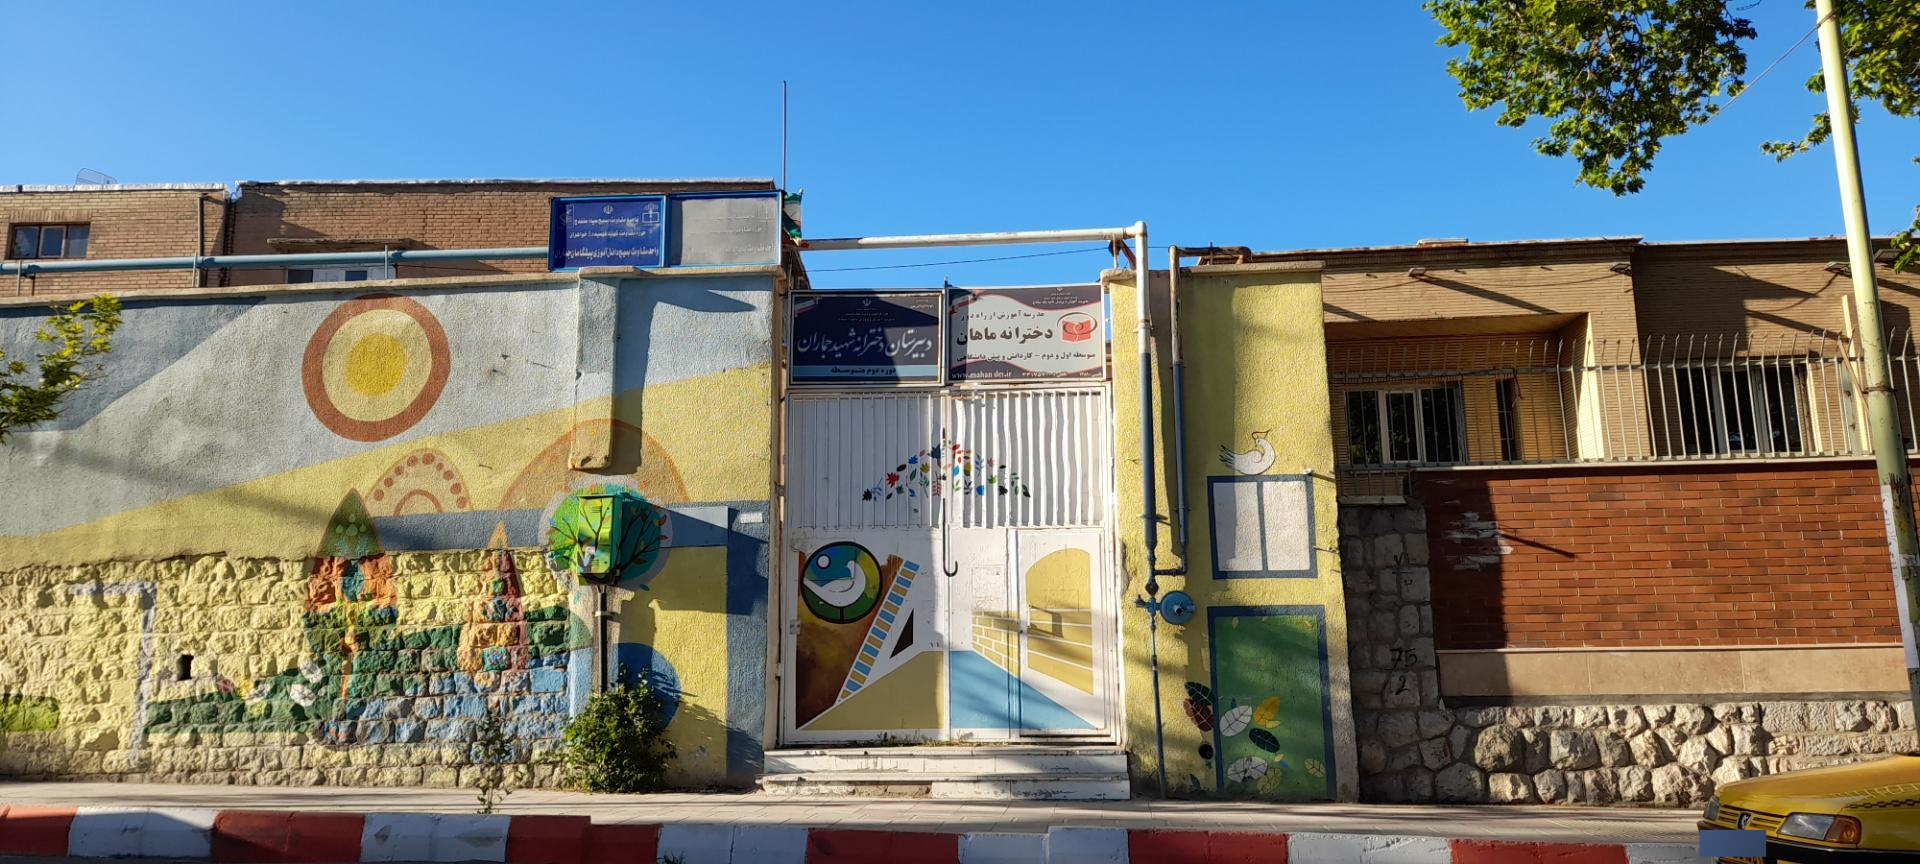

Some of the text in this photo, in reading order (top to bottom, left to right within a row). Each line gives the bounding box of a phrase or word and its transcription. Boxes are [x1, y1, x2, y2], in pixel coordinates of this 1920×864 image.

[960, 309, 1045, 322] مدرسه آموزش از راه دور
[956, 325, 1053, 346] دخترانه ماهان
[797, 327, 933, 359] دبیرستان دخترانه شهید جماران
[956, 352, 986, 362] دانشگاهی
[1007, 351, 1032, 361] کاردانش
[1060, 352, 1072, 360] اول
[831, 366, 897, 376] دوره دوم متوسطه
